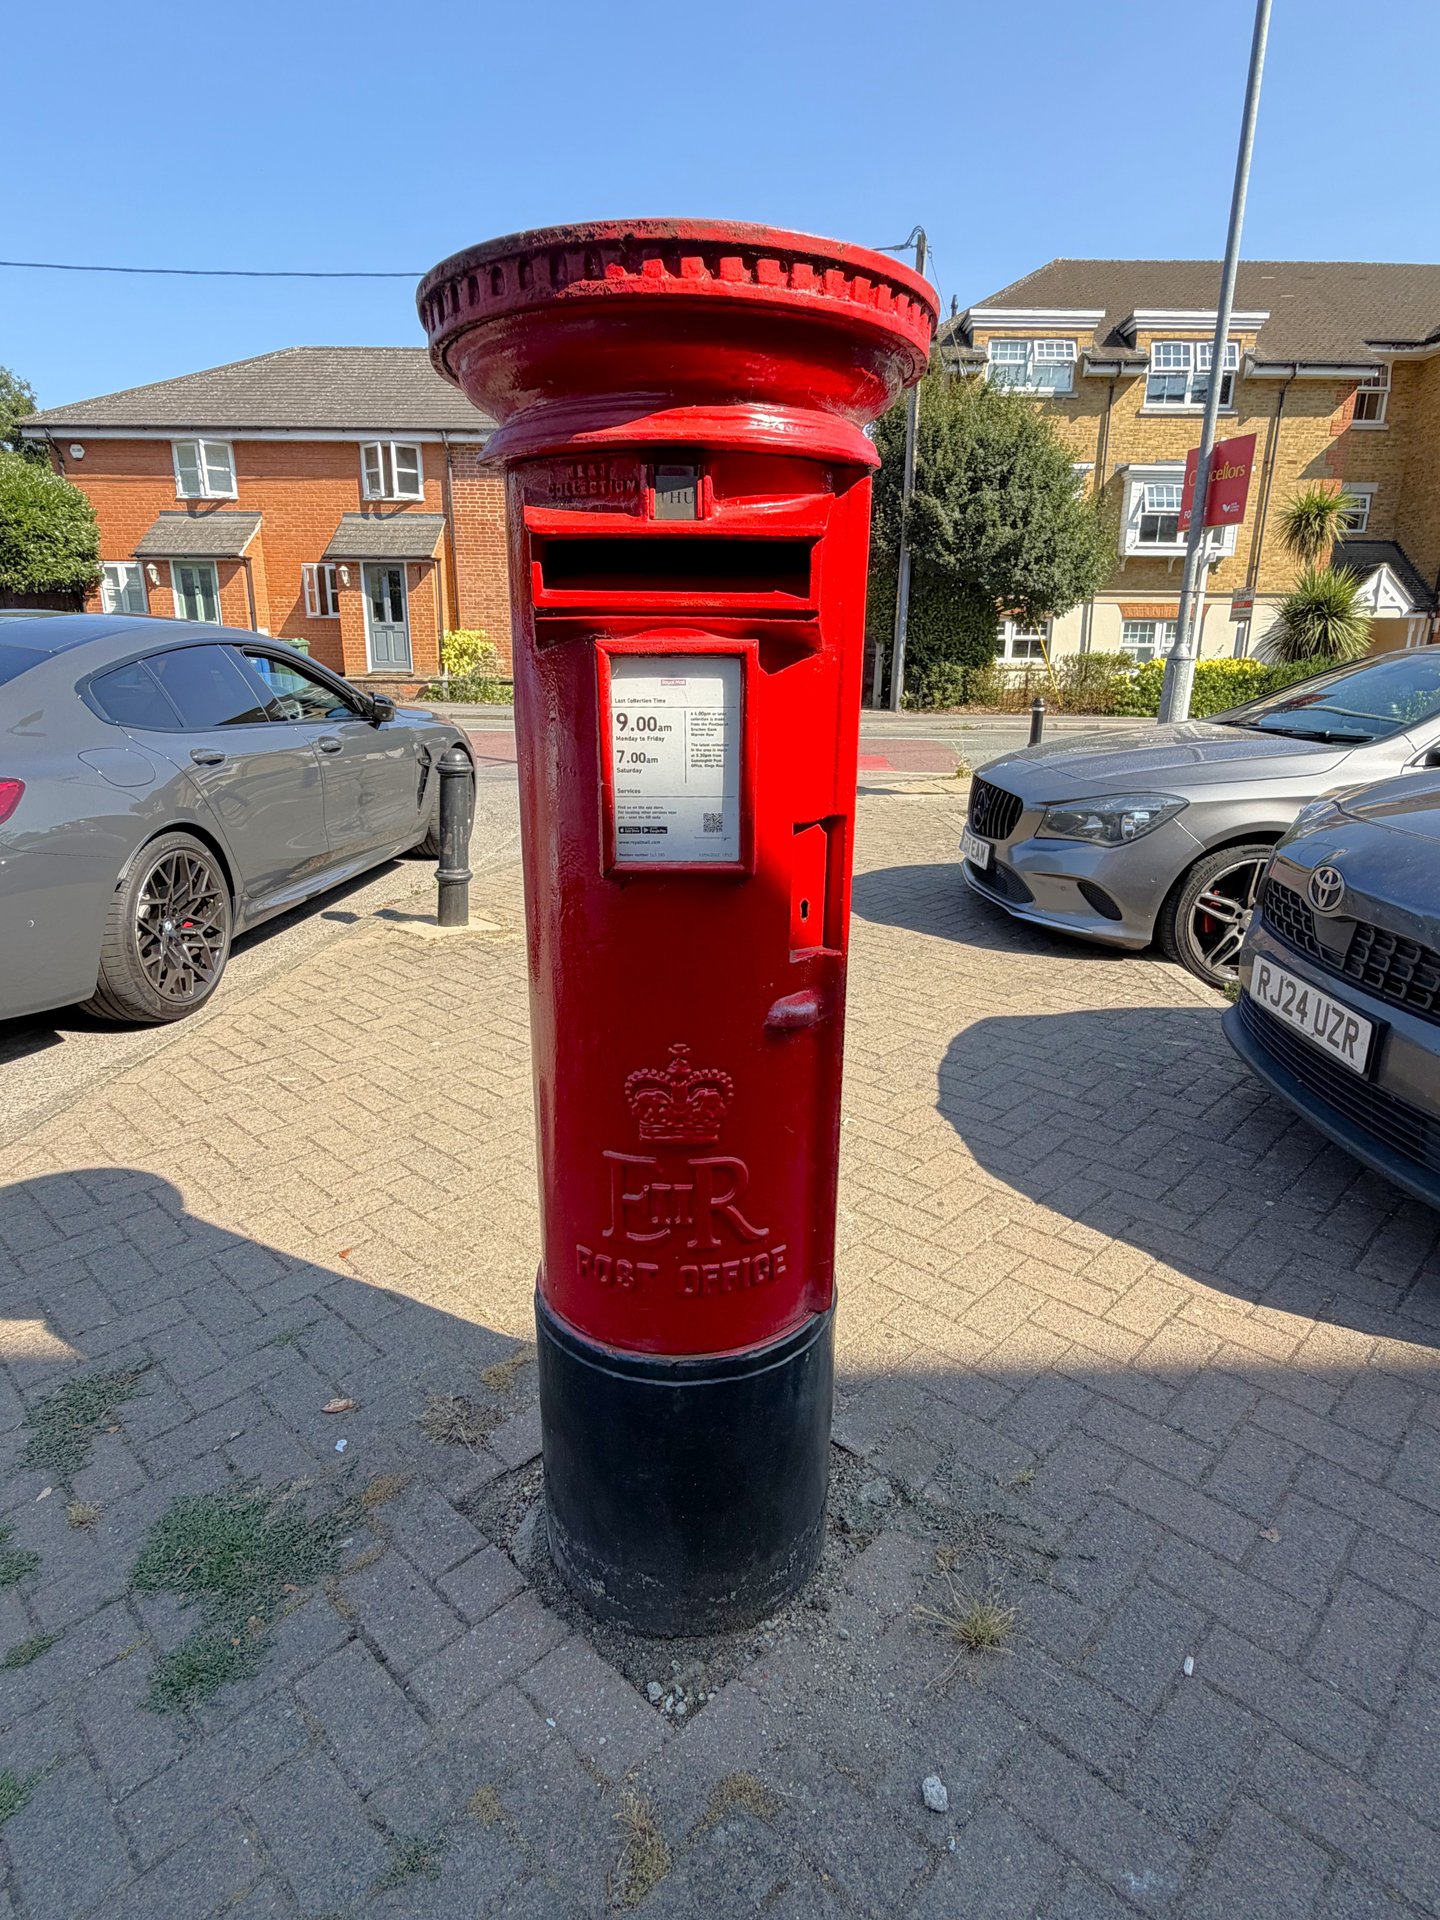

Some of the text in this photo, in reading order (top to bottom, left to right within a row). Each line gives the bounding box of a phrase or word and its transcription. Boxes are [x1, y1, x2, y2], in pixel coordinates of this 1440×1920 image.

[1188, 461, 1246, 486] Ccellors
[546, 479, 635, 496] COLLECTION
[616, 712, 672, 732] 9.00am
[616, 750, 658, 763] 7.00am
[1257, 964, 1360, 1060] RJ24 UZR
[576, 1244, 787, 1294] POST OFFICE
